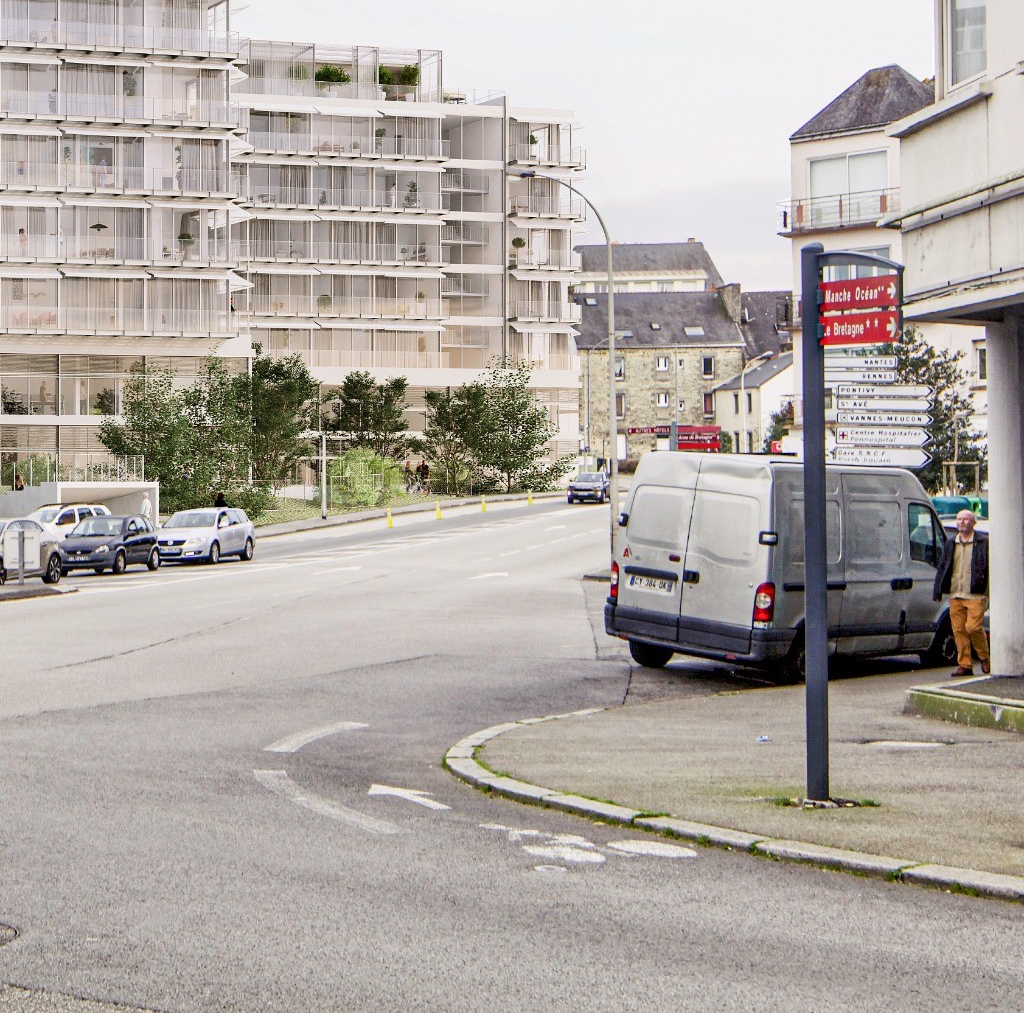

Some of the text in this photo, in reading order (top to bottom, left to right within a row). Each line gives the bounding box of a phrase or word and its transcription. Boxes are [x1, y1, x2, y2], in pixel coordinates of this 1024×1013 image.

[825, 285, 878, 303] Manche Océan
[833, 322, 864, 338] Bretagne
[878, 430, 922, 438] Hospitalier
